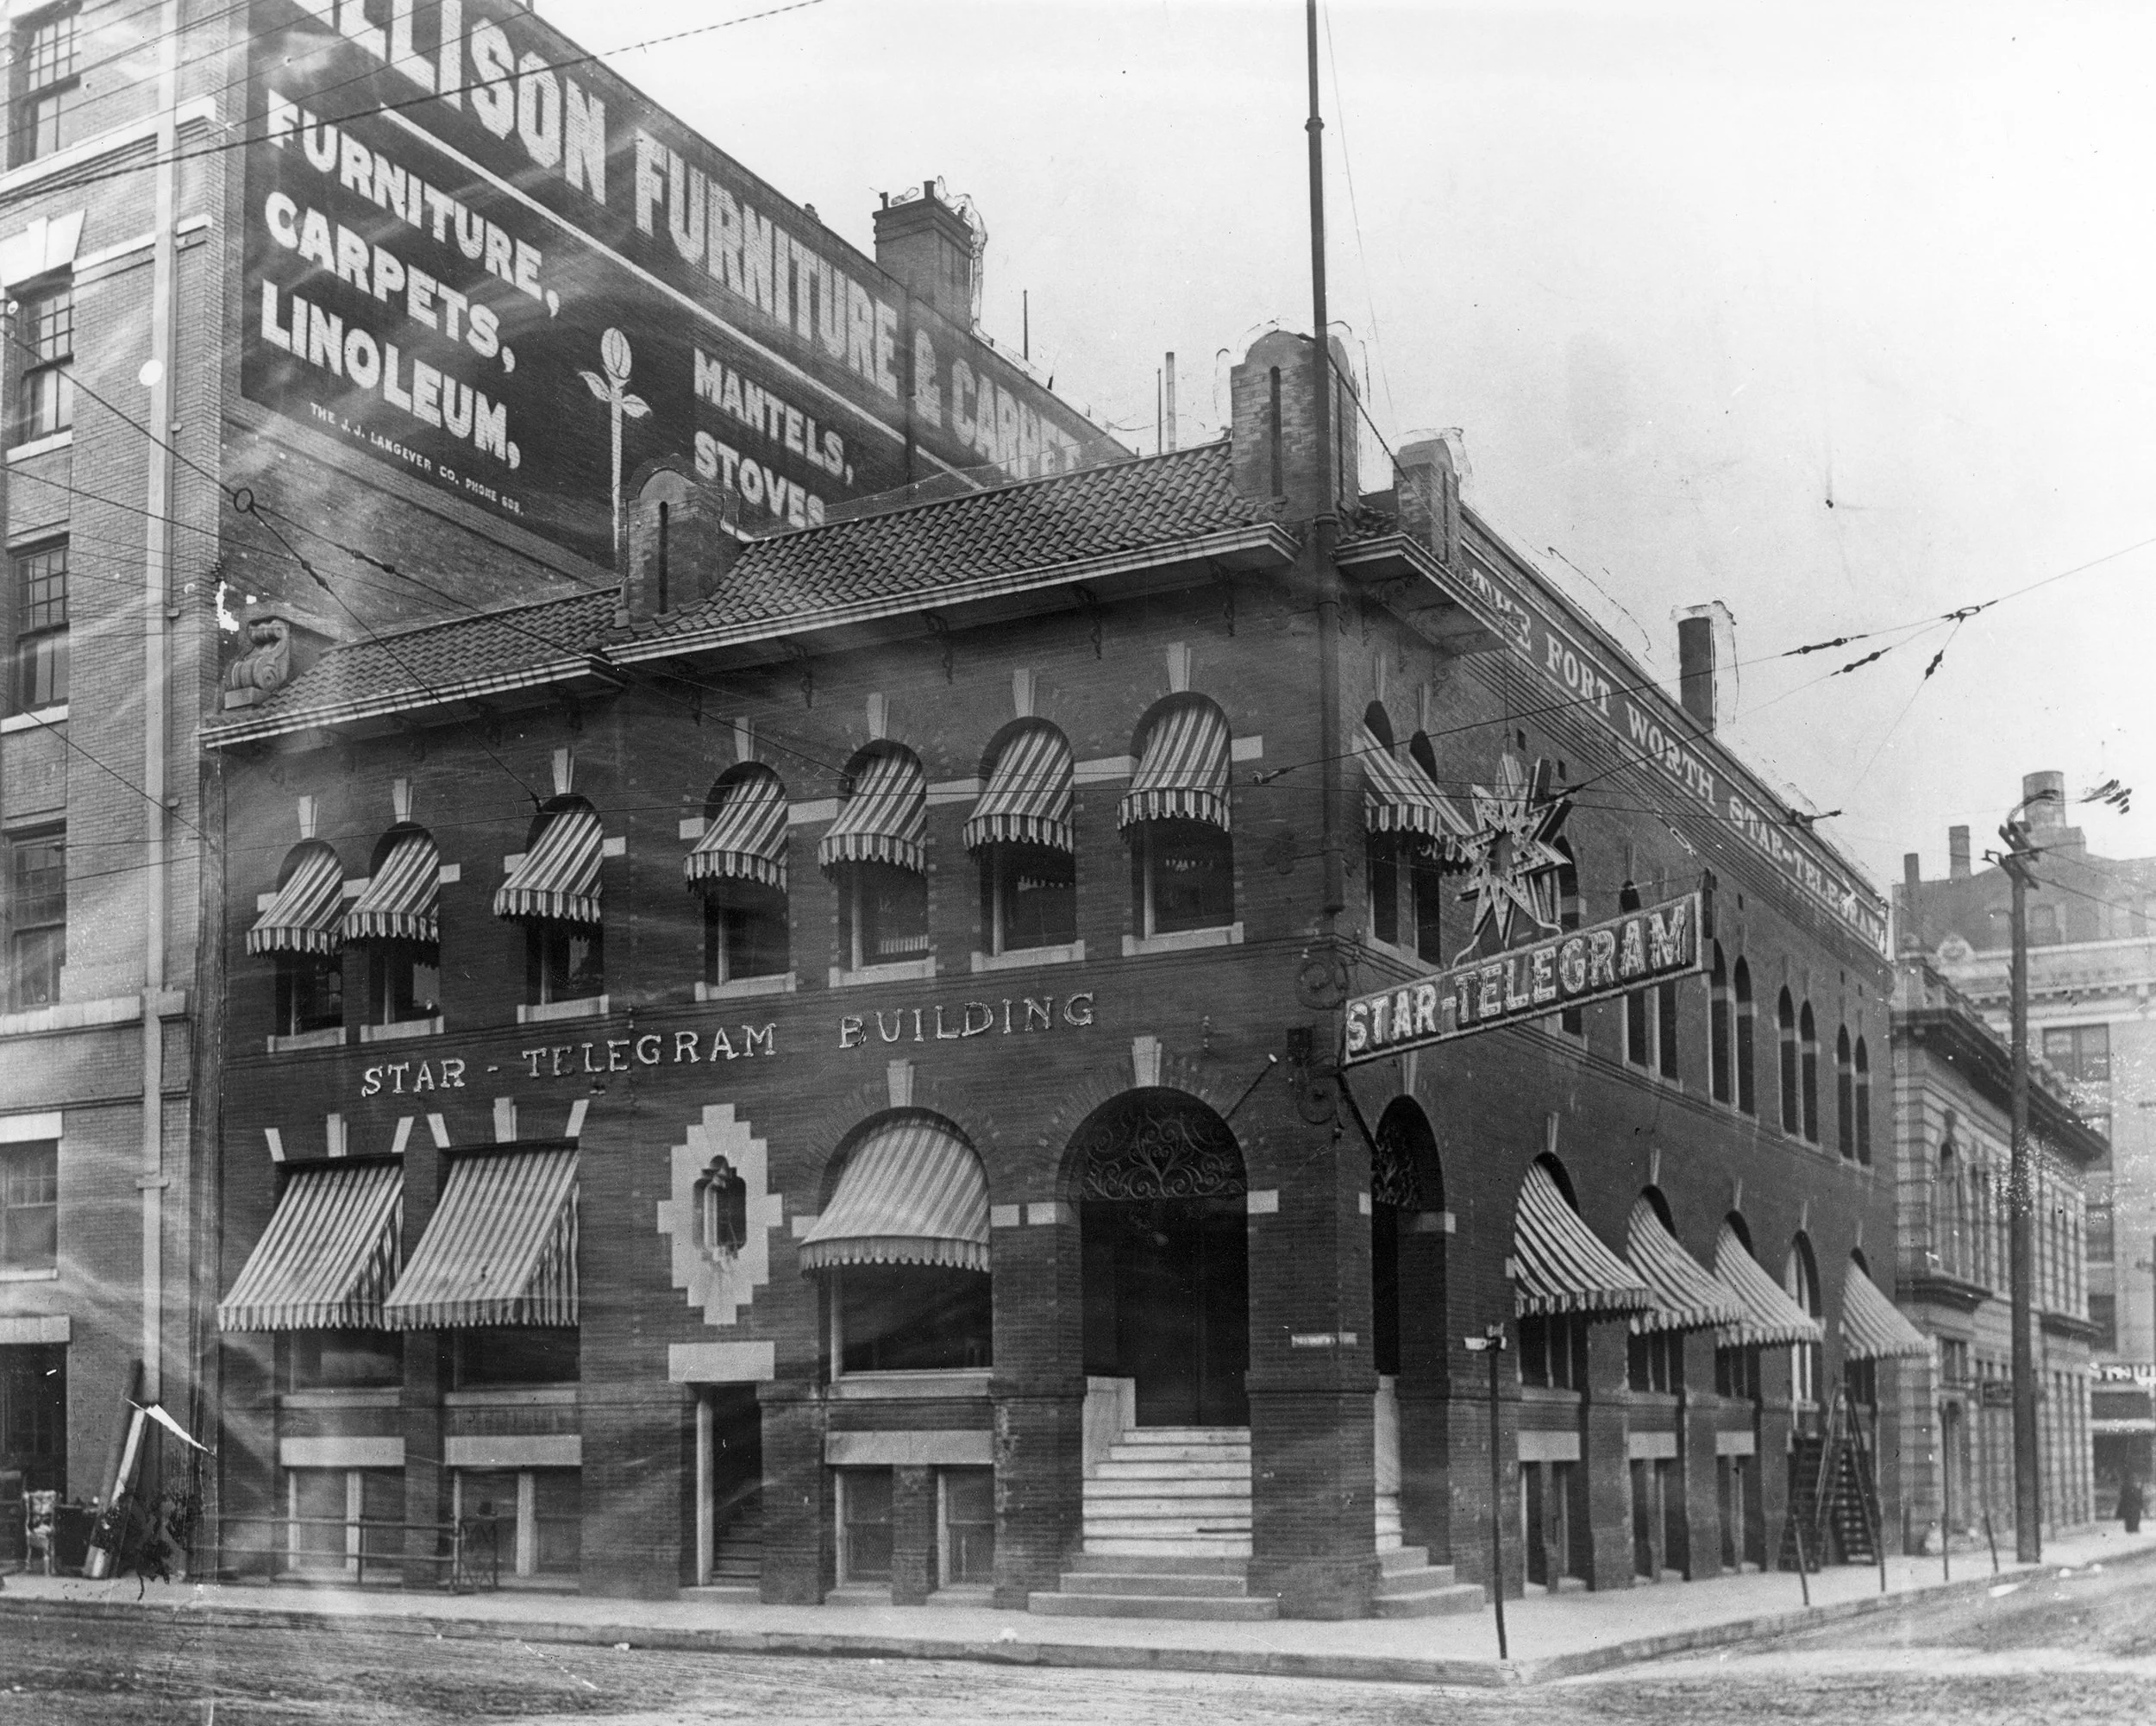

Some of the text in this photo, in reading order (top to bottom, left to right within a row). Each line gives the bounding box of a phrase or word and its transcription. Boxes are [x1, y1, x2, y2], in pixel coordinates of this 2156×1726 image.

[265, 191, 516, 373] CARPETS,
[267, 88, 560, 318] FURNITURE,
[636, 127, 898, 399] FURNITURE
[912, 329, 942, 428] &
[261, 278, 521, 469] LINOLEUM,
[310, 402, 335, 425] THE
[371, 431, 431, 471] LANGEVER
[439, 465, 460, 485] CO.
[694, 347, 853, 486] MANTELS,
[1545, 631, 1613, 717] FORT
[1625, 700, 1717, 807] WORTH
[360, 1058, 466, 1096] STAR
[523, 1023, 776, 1077] TELEGRAM
[838, 993, 1094, 1048] BUILDING
[1345, 903, 1688, 1051] STAR-TELEGRAM
